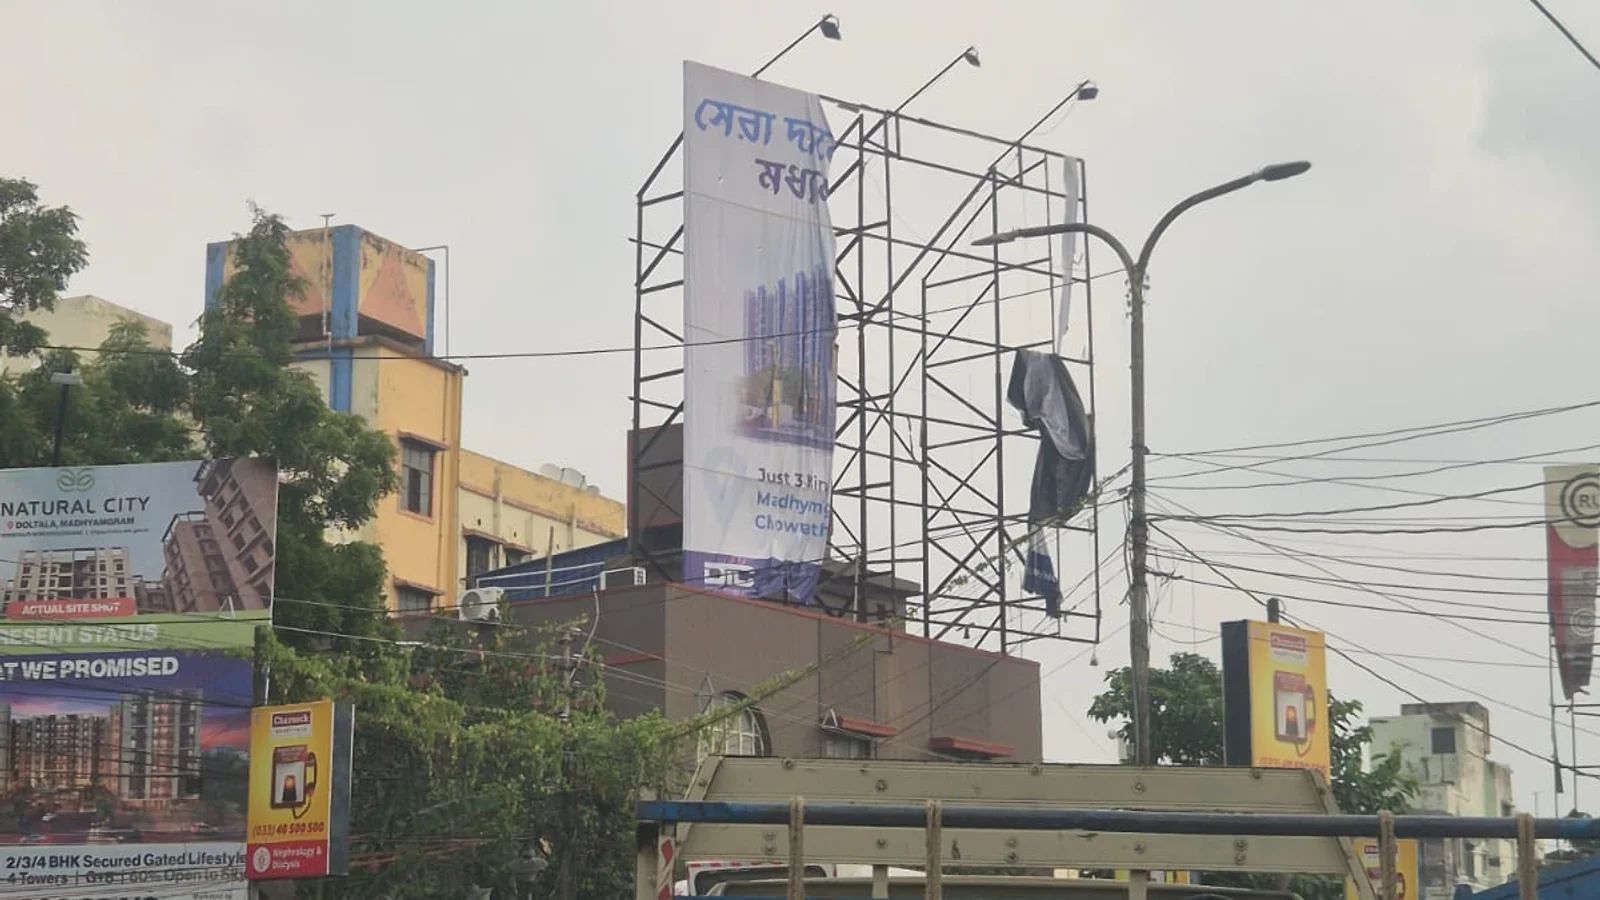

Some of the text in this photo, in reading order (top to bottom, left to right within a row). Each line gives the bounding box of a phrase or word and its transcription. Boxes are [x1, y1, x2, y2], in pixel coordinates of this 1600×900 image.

[695, 98, 776, 145] সেরা
[757, 467, 790, 486] Just
[794, 473, 803, 487] 3
[1, 496, 150, 516] NATURAL CITY
[22, 602, 121, 615] ACTUAL SITE SHOT
[80, 623, 157, 643] STATUS
[22, 660, 57, 680] WE
[60, 656, 179, 679] PROMISED
[289, 822, 306, 834] 500
[307, 821, 325, 833] 500
[6, 856, 46, 869] 2/3/4
[49, 855, 80, 868] BHK
[83, 854, 141, 868] Secured
[144, 853, 186, 867] Gated
[19, 872, 69, 885] Towers
